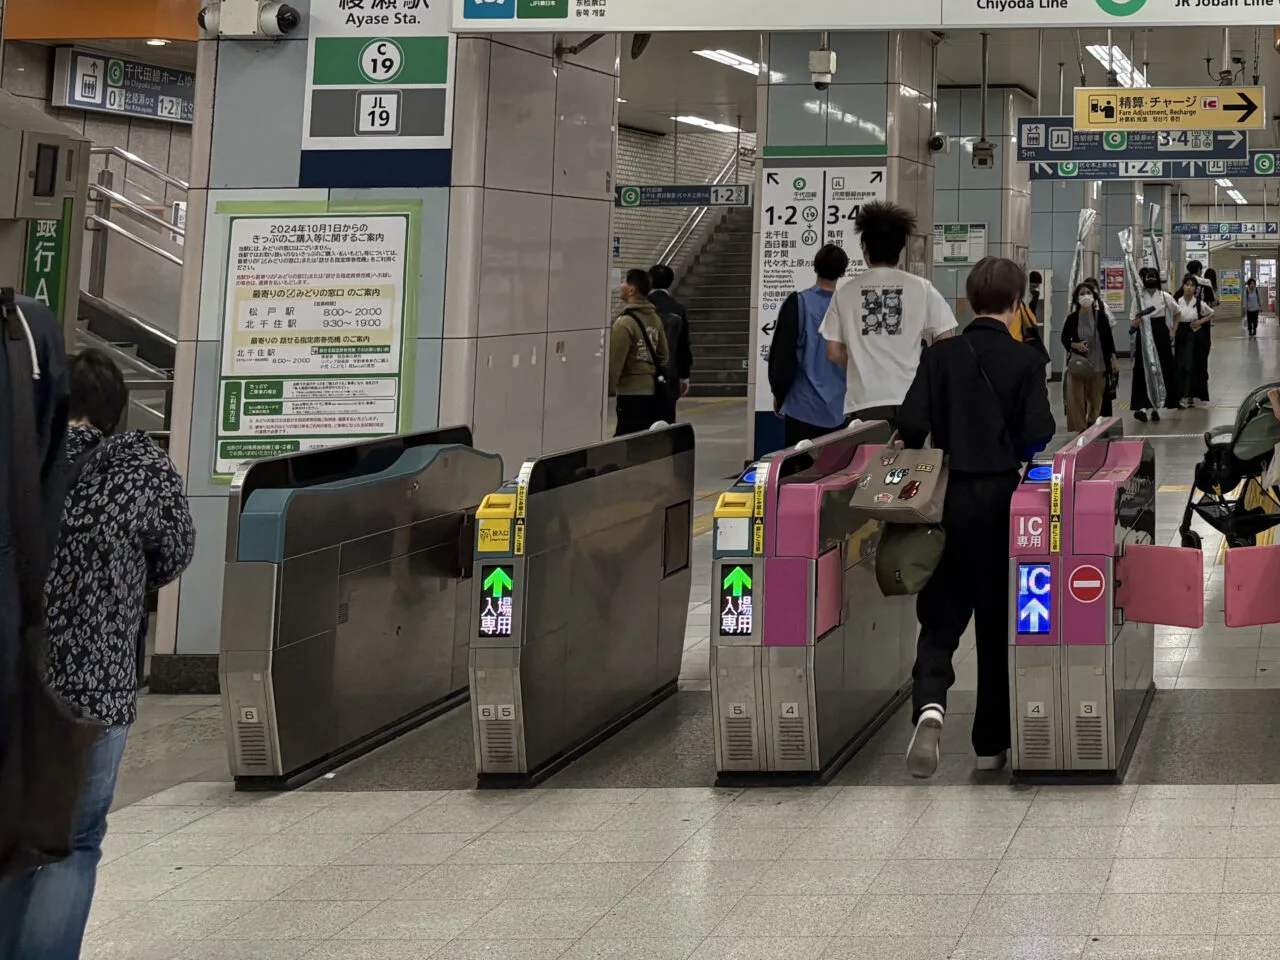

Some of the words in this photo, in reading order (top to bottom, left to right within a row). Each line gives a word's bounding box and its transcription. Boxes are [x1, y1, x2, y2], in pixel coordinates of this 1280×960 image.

[346, 13, 389, 28] Ayase
[394, 12, 421, 25] Sta.
[377, 43, 387, 55] C
[371, 58, 394, 73] 19
[125, 63, 196, 87] 千代田線ホームゆ
[109, 90, 116, 106] 0
[372, 97, 386, 109] JL
[368, 110, 390, 127] 19
[1055, 133, 1067, 144] JL
[1111, 134, 1118, 143] C
[1022, 150, 1036, 158] 5m
[627, 192, 633, 200] C
[270, 224, 368, 234] 2024年10月1日からの
[827, 230, 844, 238] 亀有
[252, 233, 384, 243] きっぷのご購入等に関するご案内
[765, 231, 789, 239] 北千住
[764, 240, 797, 249] 西日暮里
[1019, 516, 1043, 536] IC
[1017, 536, 1041, 547] 専用
[1019, 567, 1050, 595] IC
[481, 597, 512, 617] 入場
[722, 596, 752, 615] 入場
[480, 617, 512, 635] 専用
[721, 615, 752, 634] 専用
[502, 708, 511, 717] 5
[733, 706, 742, 715] 5
[786, 706, 794, 714] 4
[1031, 705, 1040, 714] 4
[1084, 705, 1093, 714] 3
[245, 711, 254, 720] 6
